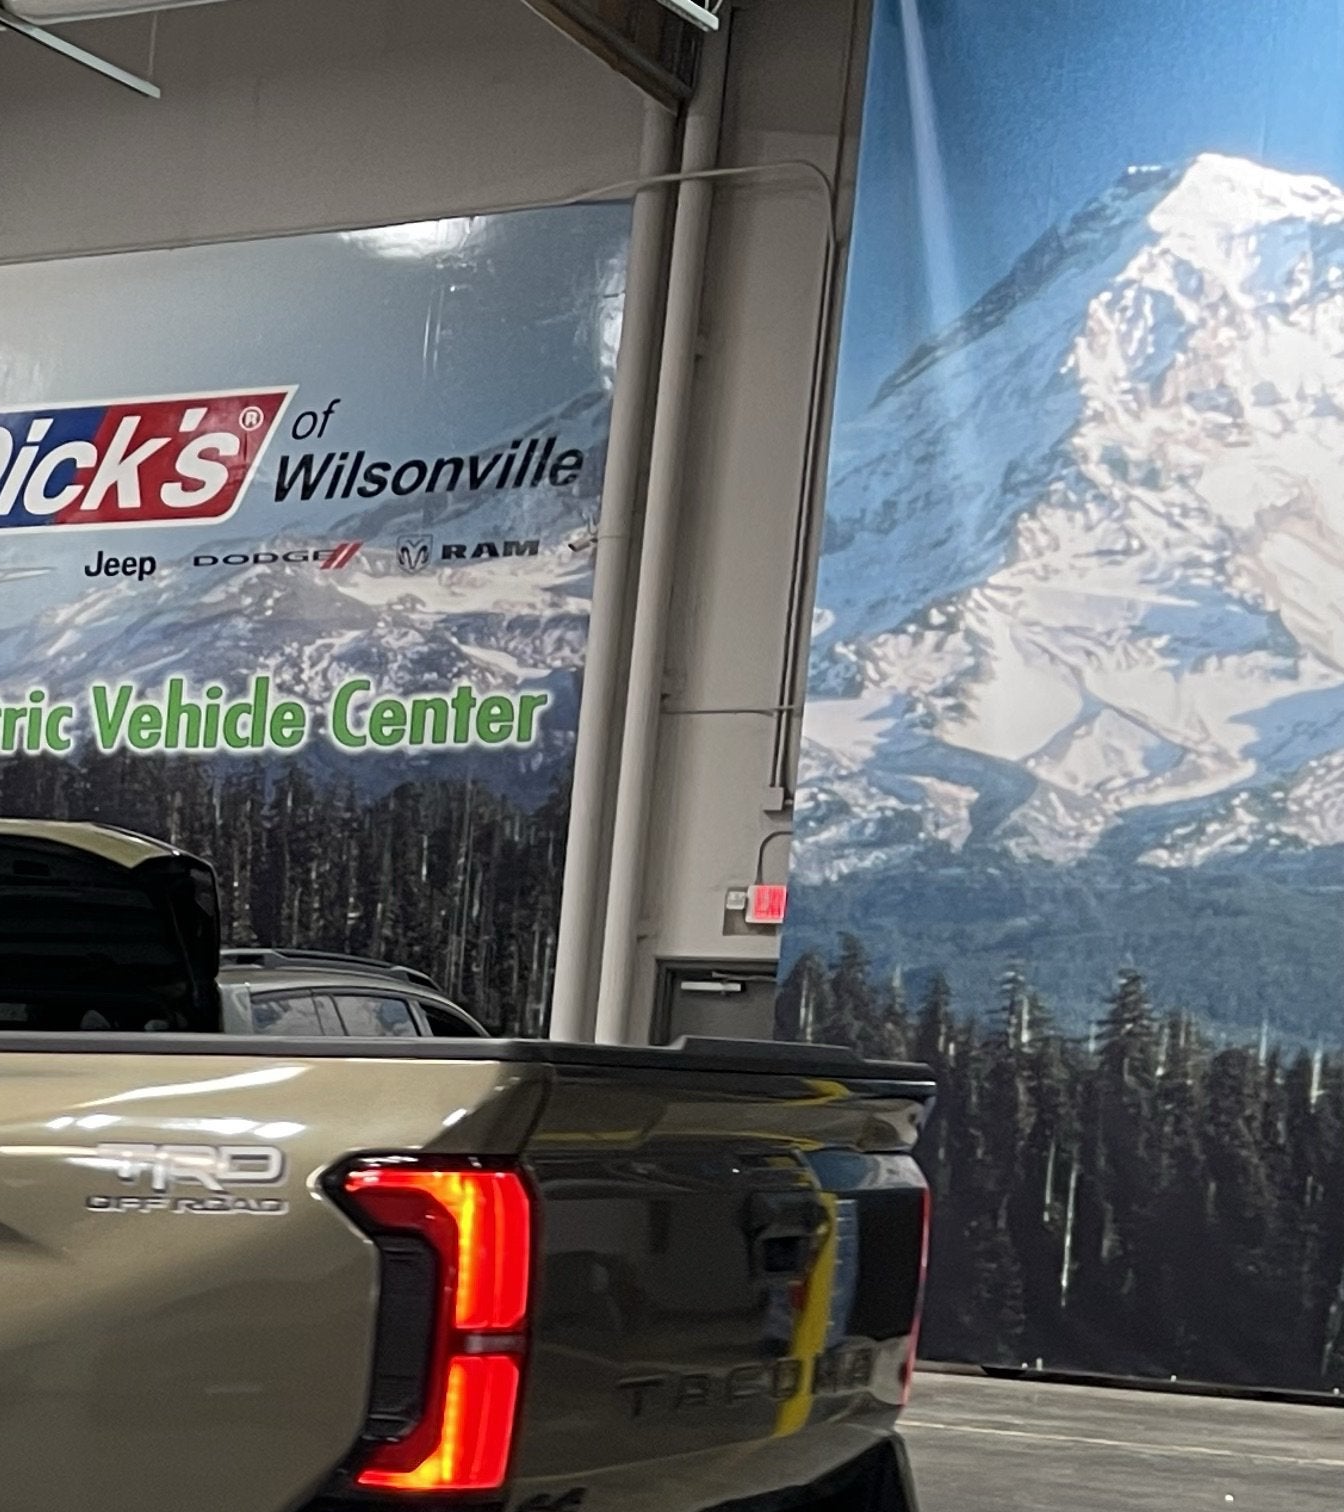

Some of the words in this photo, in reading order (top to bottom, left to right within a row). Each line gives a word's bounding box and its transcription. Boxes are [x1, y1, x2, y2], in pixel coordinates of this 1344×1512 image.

[291, 398, 342, 441] of
[274, 436, 585, 503] Wilsonville
[84, 550, 157, 582] Jeep
[193, 548, 334, 567] DODGE
[441, 540, 540, 560] RAM
[92, 677, 306, 751] Vehicle
[331, 678, 549, 748] Center
[96, 1143, 288, 1193] TRD
